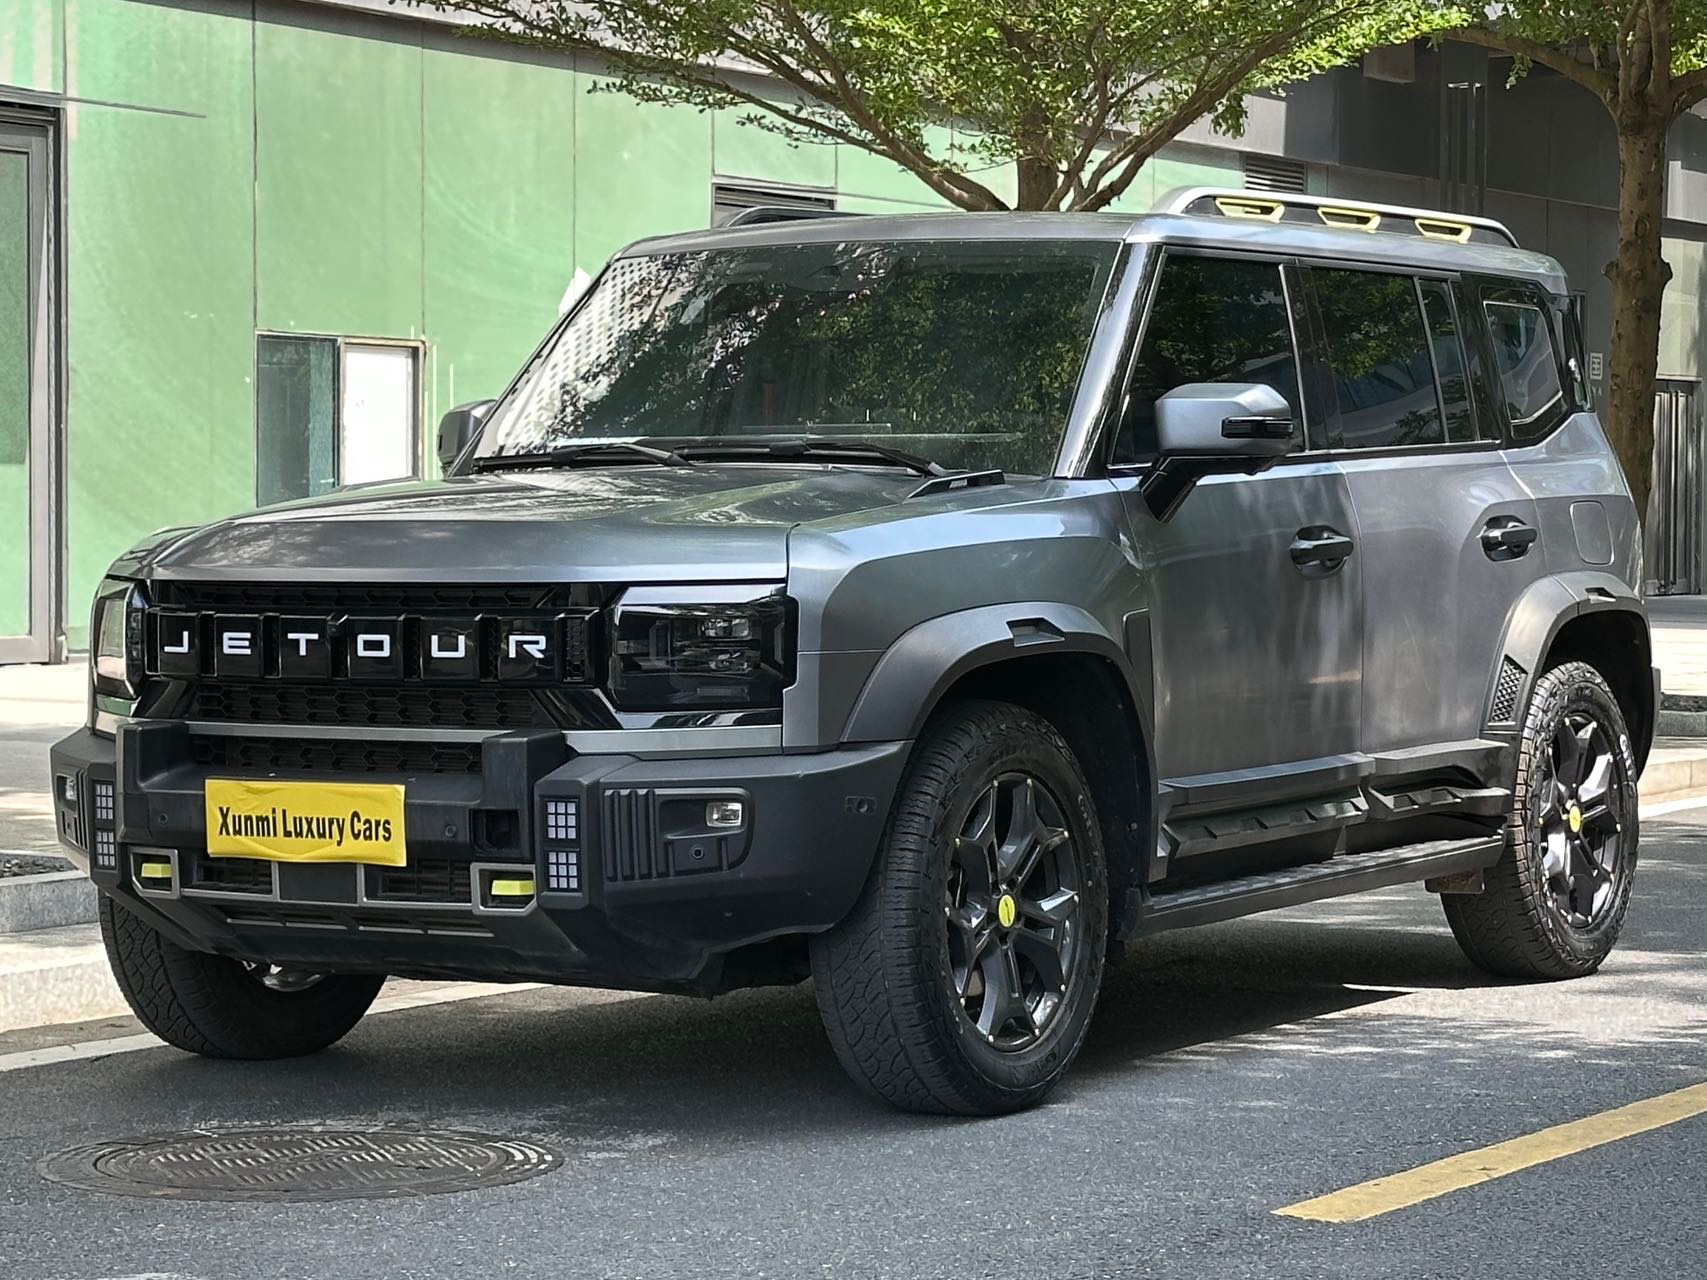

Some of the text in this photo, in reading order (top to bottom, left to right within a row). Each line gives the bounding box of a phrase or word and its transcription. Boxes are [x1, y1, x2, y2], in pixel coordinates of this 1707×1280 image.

[163, 630, 546, 659] JETOUR
[218, 806, 393, 847] Xunmi Luxury Cars
